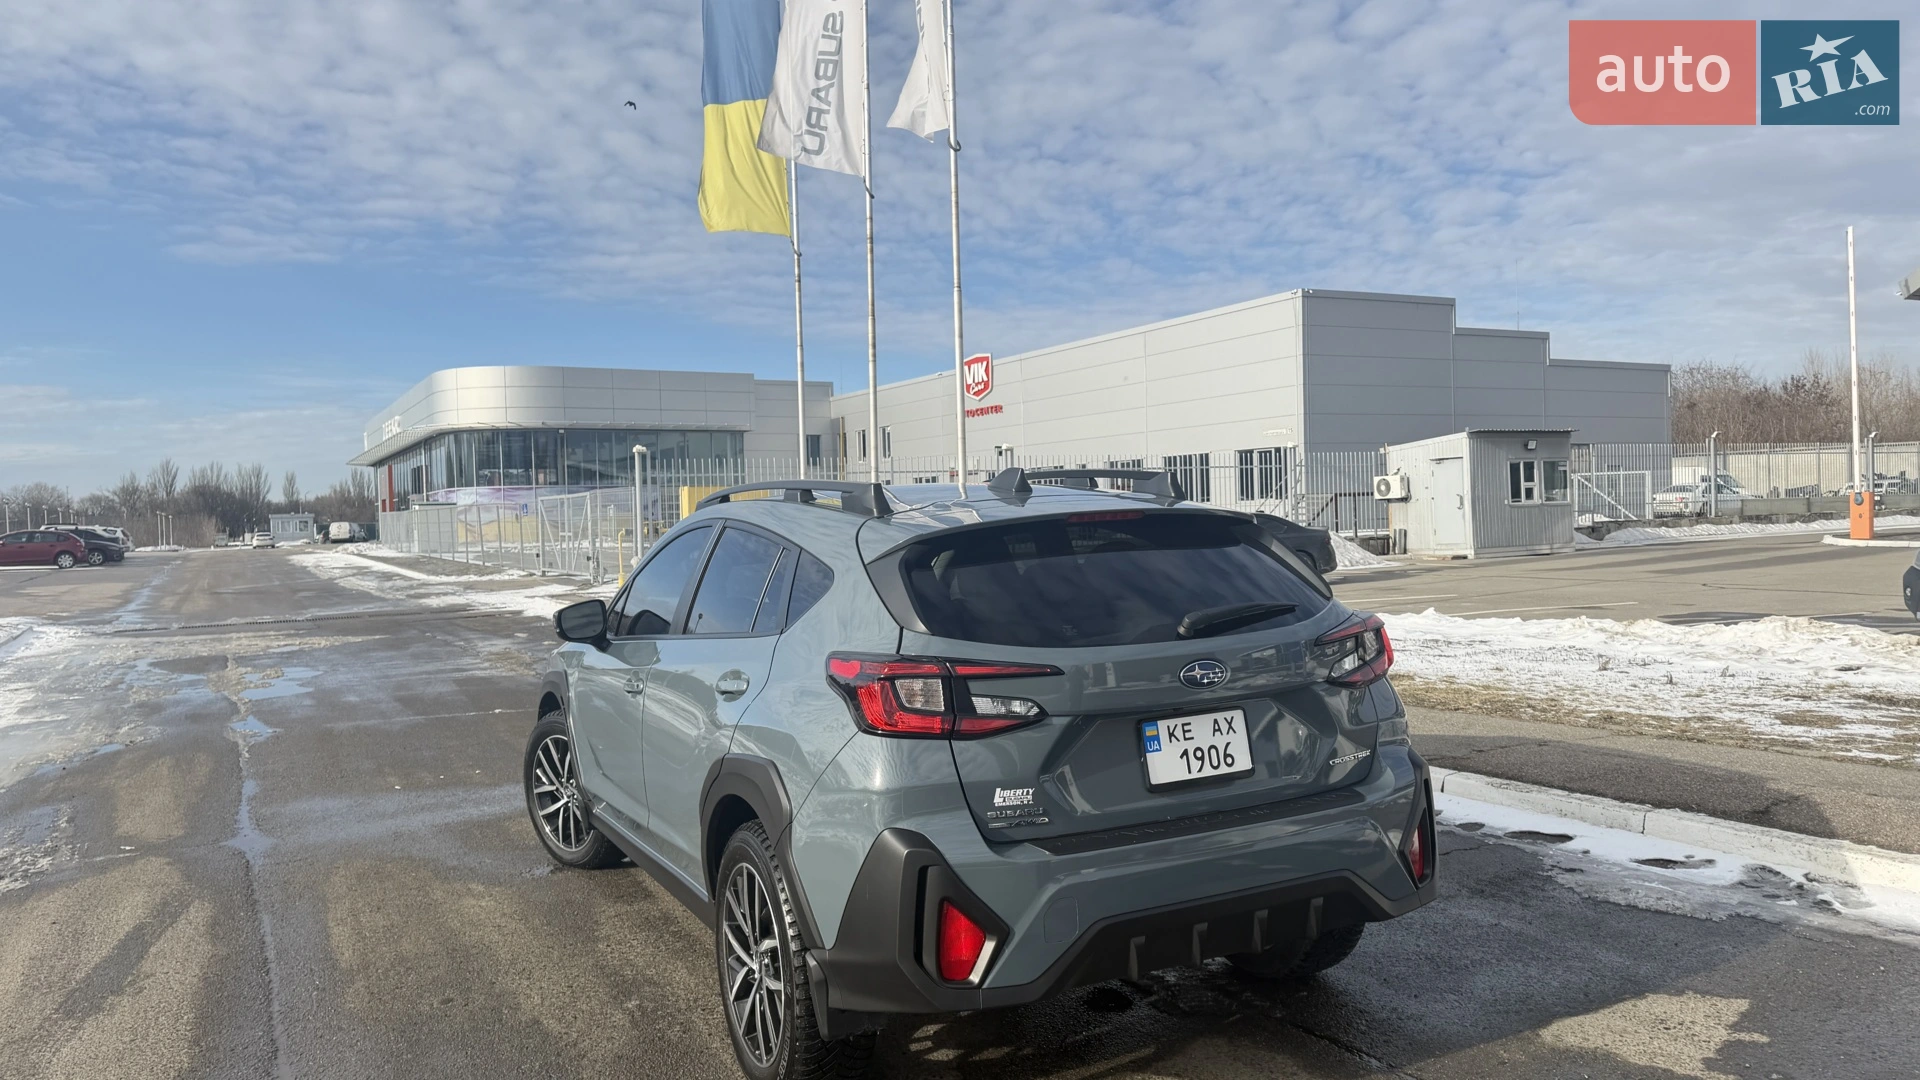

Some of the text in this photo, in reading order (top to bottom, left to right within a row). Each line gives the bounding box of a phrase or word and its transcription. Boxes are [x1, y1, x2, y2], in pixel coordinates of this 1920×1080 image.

[964, 361, 988, 385] VIK
[1167, 716, 1237, 743] KE AX
[1147, 741, 1160, 751] UA
[1179, 742, 1235, 774] 1906
[1329, 749, 1371, 765] CROSSTREK
[993, 787, 1036, 803] LIBERTY
[987, 807, 1043, 818] SUBARU
